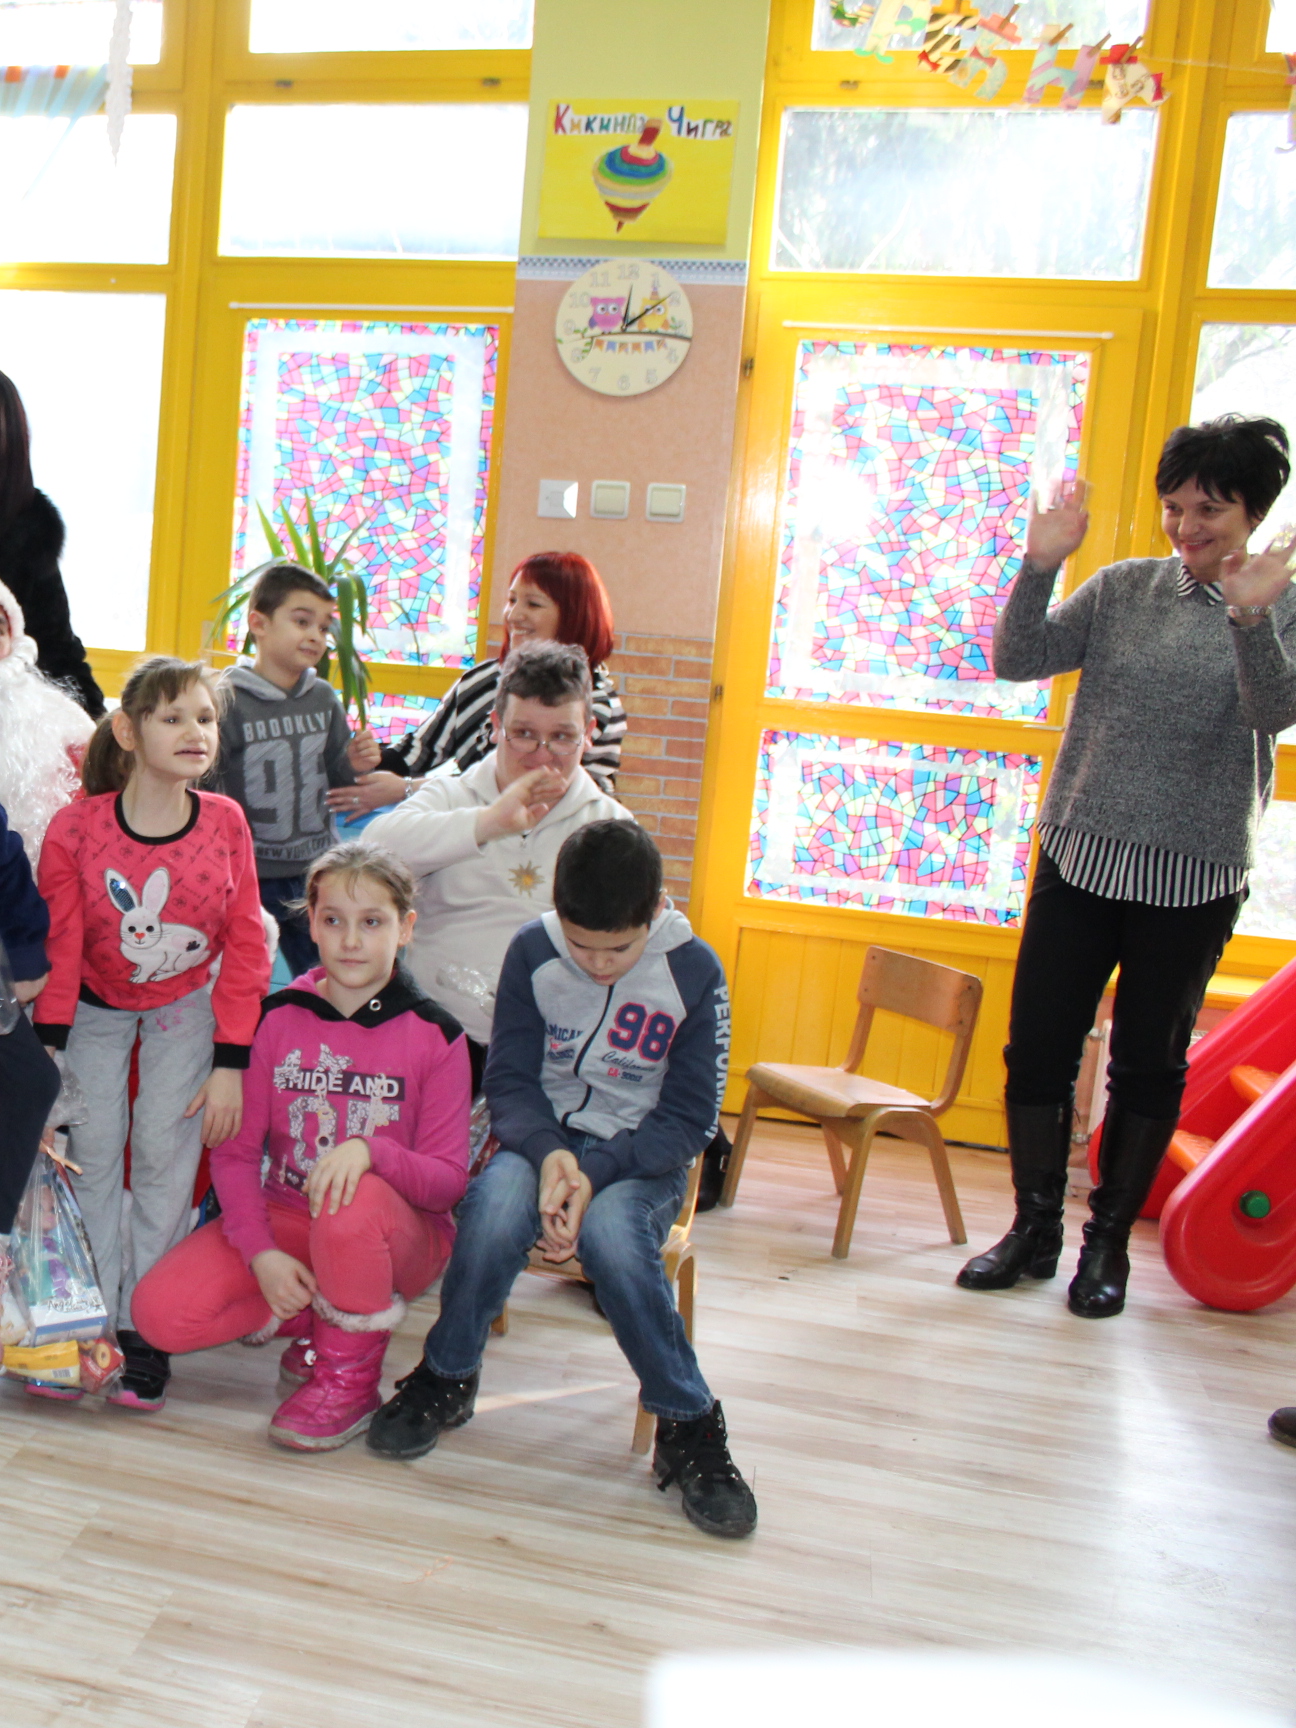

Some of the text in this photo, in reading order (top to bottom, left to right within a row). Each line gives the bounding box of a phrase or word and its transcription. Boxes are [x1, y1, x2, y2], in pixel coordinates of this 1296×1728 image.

[590, 271, 611, 287] 11
[589, 366, 601, 383] 7
[607, 1002, 677, 1063] 98
[288, 1073, 400, 1098] HIDE AND
